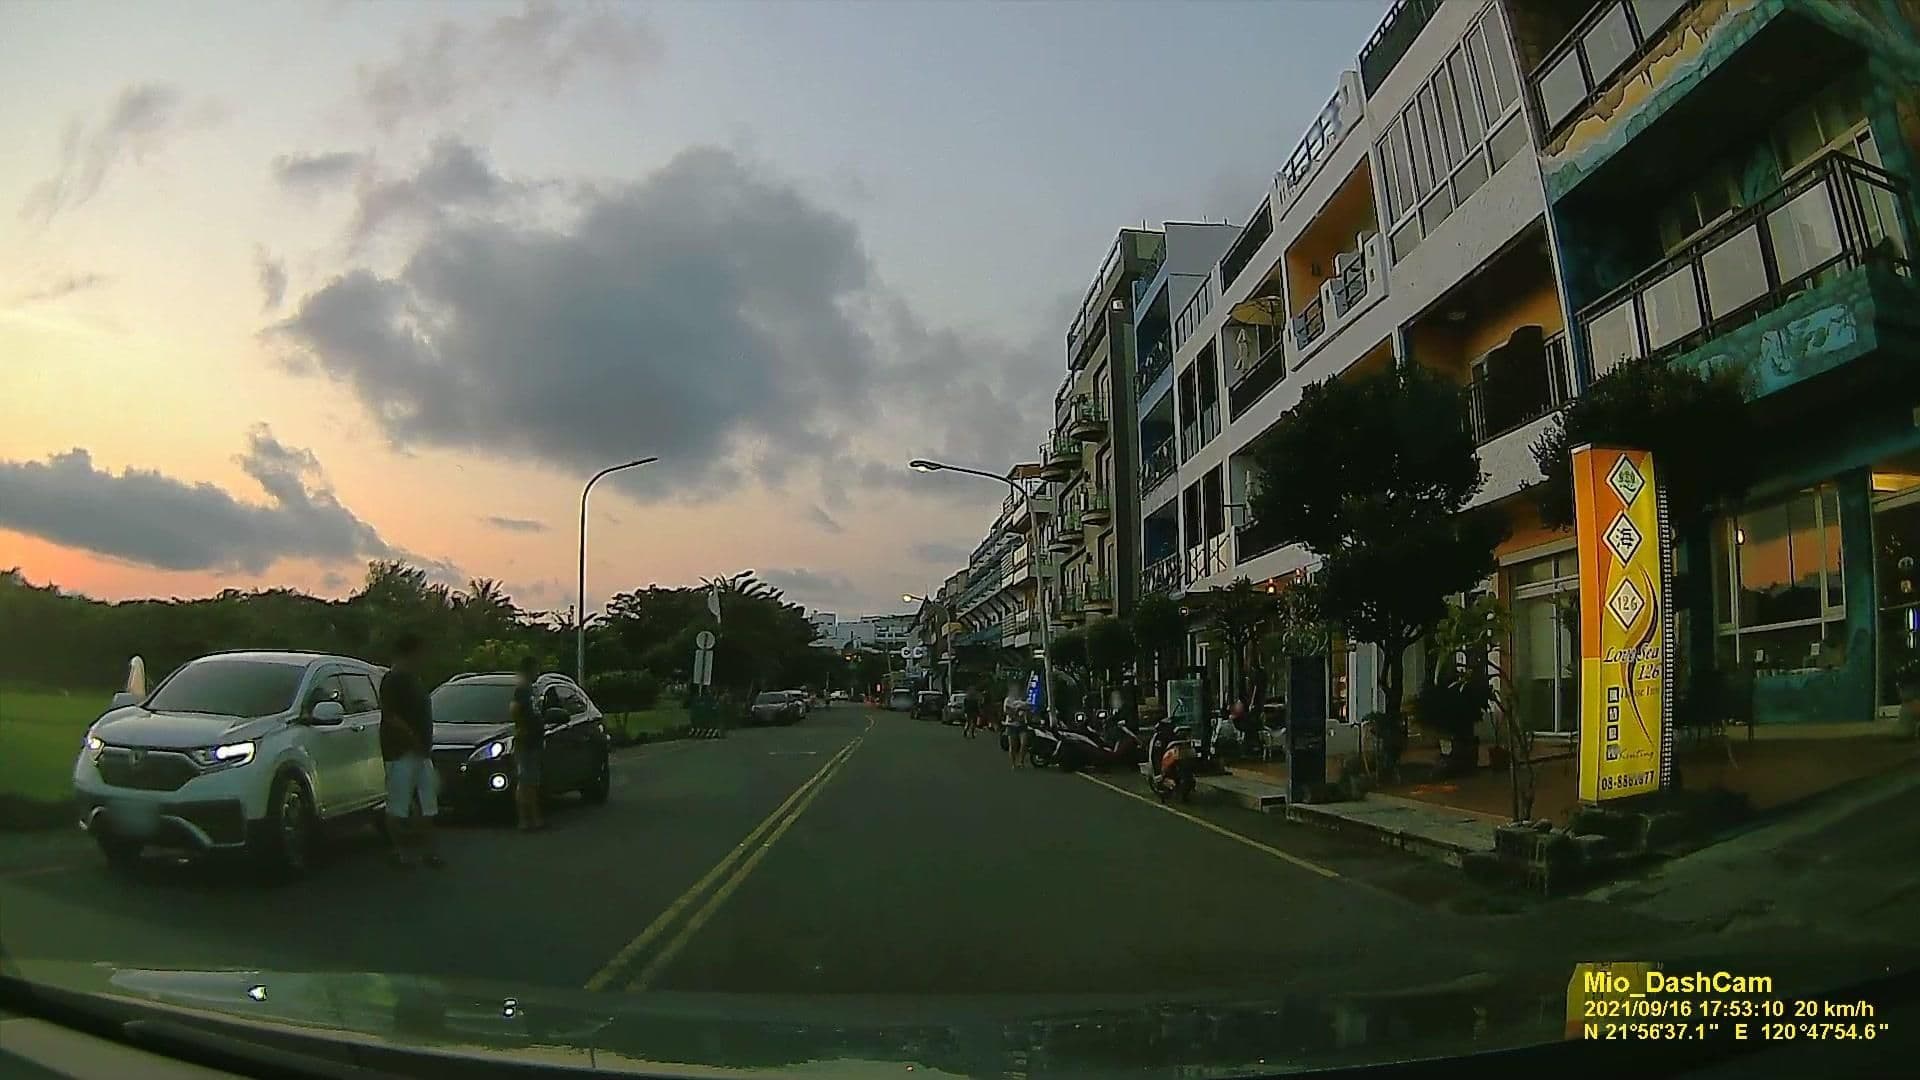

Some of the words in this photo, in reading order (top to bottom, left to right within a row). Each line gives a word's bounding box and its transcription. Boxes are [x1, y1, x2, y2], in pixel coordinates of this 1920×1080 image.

[1617, 595, 1638, 611] 126
[1638, 644, 1660, 662] Sea
[1637, 663, 1660, 680] 126
